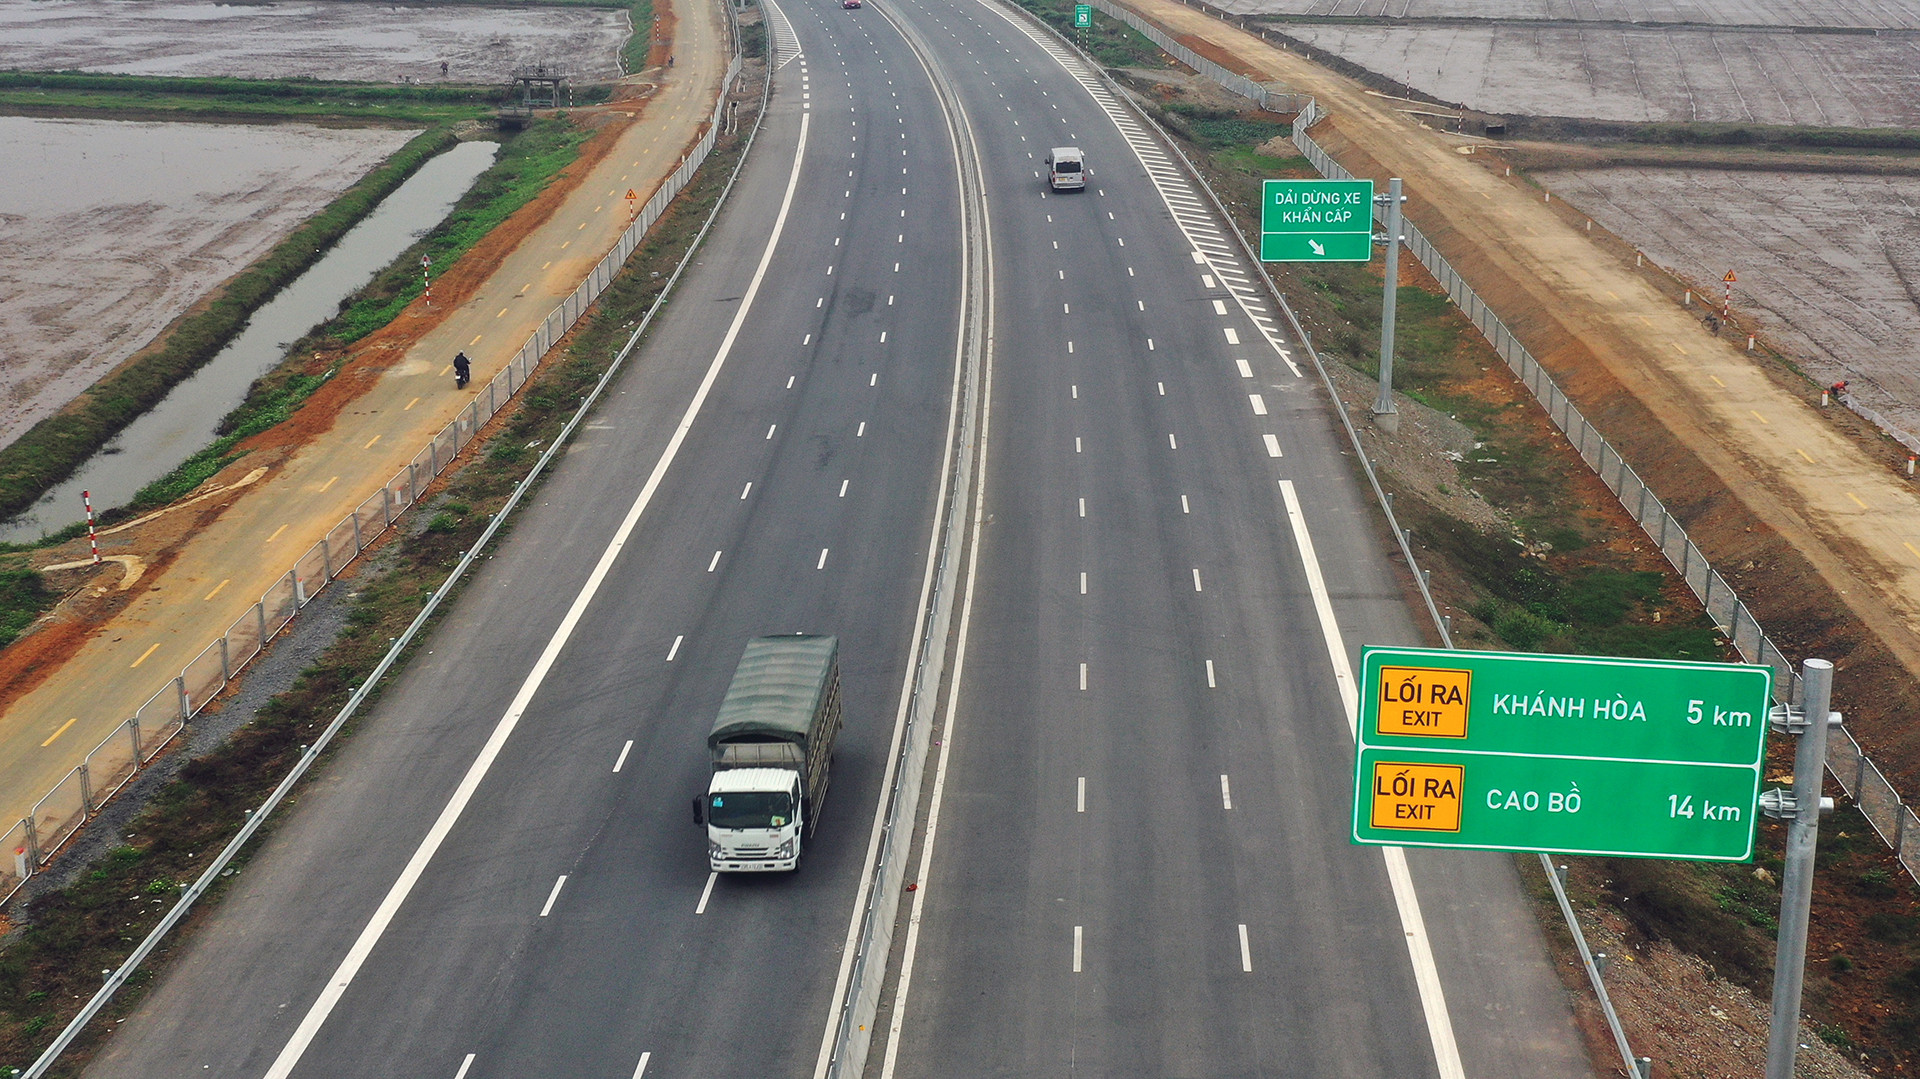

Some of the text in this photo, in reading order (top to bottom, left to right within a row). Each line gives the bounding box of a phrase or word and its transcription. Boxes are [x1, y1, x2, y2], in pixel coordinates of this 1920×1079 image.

[1275, 188, 1361, 205] DẢI DỪNG XE
[1282, 206, 1352, 223] KHẨN CẤP
[1383, 674, 1463, 706] LỐI RA
[1401, 710, 1442, 728] EXIT
[1493, 689, 1647, 722] KHÁNH HÒA
[1686, 699, 1752, 728] 5 km
[1377, 769, 1456, 800] LỐI RA
[1486, 781, 1582, 814] CAO BỒ
[1395, 803, 1436, 821] EXIT
[1668, 794, 1741, 823] 14 km
